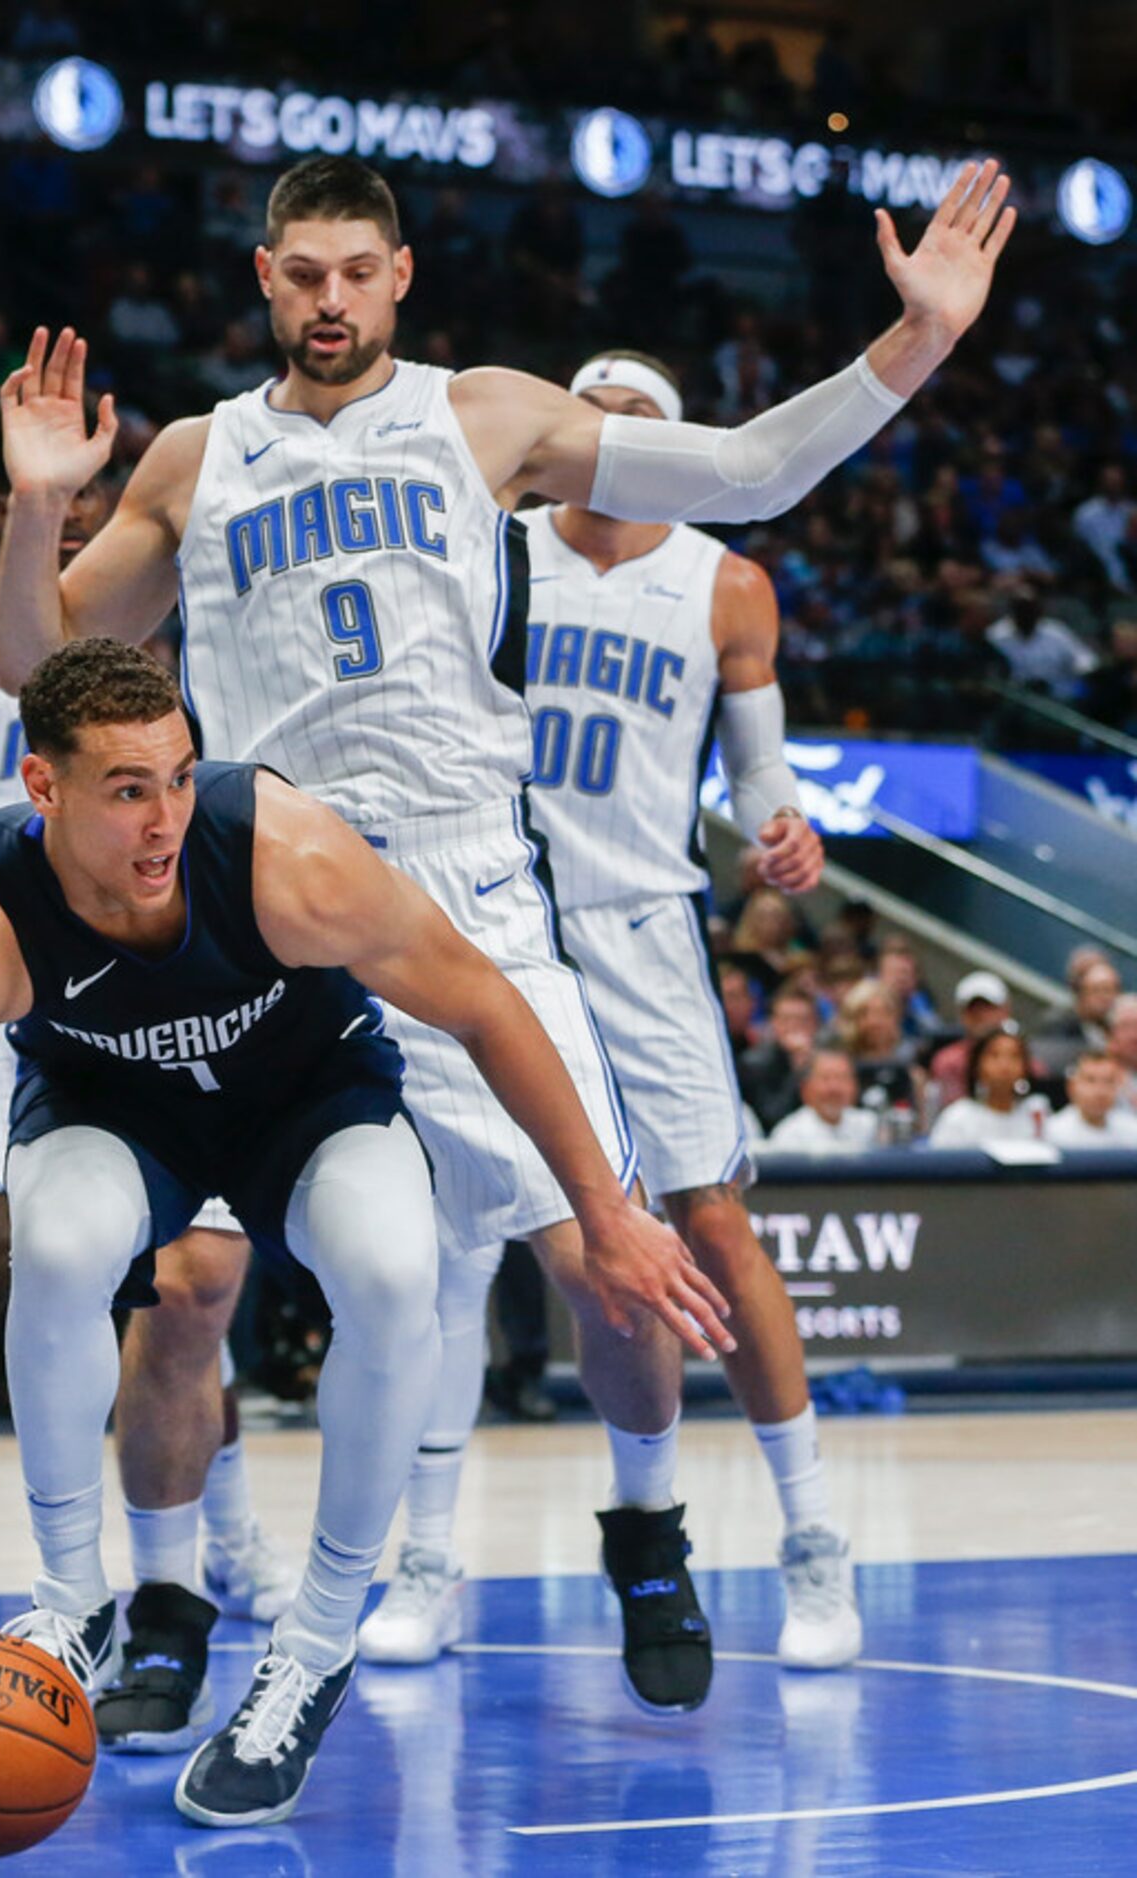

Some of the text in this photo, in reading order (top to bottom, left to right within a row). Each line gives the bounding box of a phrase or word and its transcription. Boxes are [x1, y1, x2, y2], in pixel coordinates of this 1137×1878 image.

[279, 92, 355, 155] GO
[356, 100, 496, 168] MAVS
[861, 148, 984, 211] MAV
[225, 476, 448, 597] MAGIC
[320, 578, 384, 682] 9
[532, 705, 622, 797] 00
[159, 1059, 221, 1092] 7
